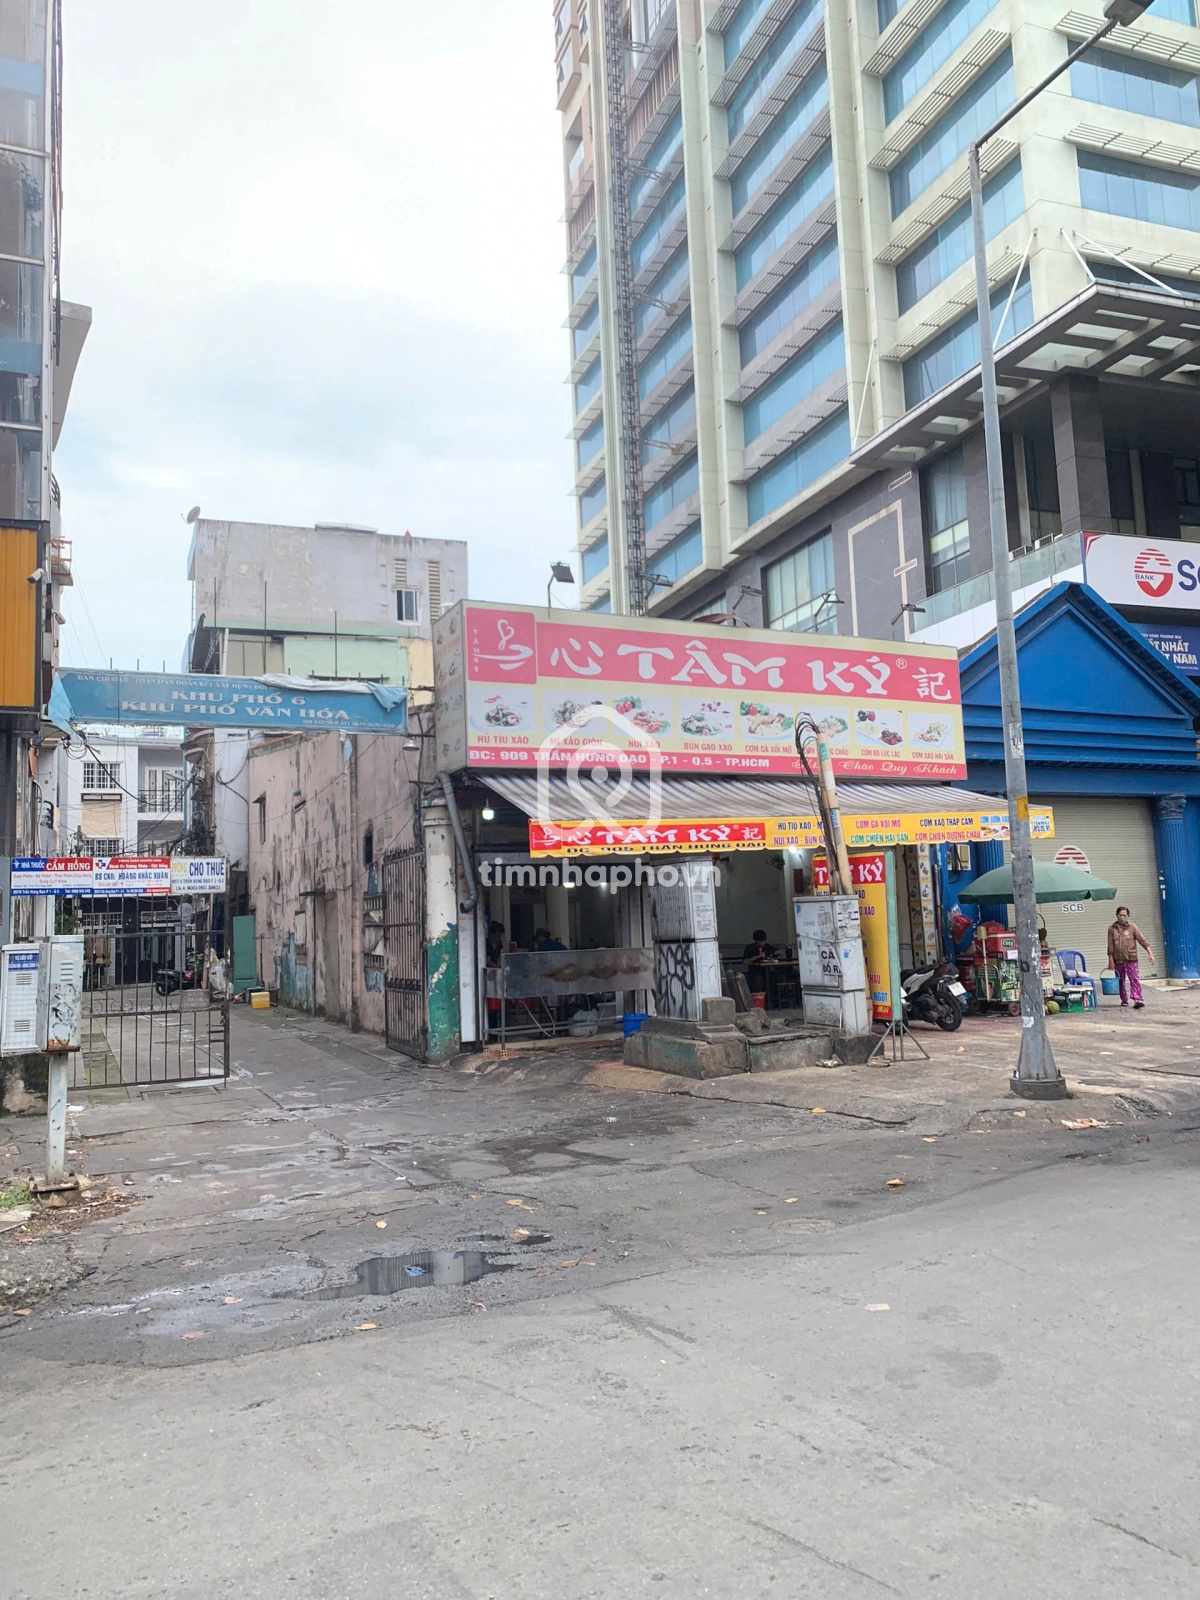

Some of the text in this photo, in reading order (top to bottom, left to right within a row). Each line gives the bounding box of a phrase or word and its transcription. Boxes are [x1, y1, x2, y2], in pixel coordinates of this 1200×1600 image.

[1162, 639, 1189, 652] NHẤT
[1173, 654, 1198, 664] NAM
[551, 638, 604, 676] 心
[617, 640, 786, 688] TÂM
[912, 667, 952, 700] 記
[172, 690, 306, 706] KHU PHỐ 6
[122, 700, 350, 720] KHU PHỐ VĂN HÓA
[478, 733, 490, 744] HỦ
[511, 734, 529, 744] XÀO
[563, 736, 580, 746] XÀO
[628, 740, 642, 748] NUI
[745, 744, 758, 752] CƠM
[760, 744, 769, 753] GÀ
[469, 750, 496, 760] ĐC:
[500, 751, 528, 761] 909
[532, 750, 572, 761] TRẦN
[576, 752, 614, 763] HƯNG
[618, 754, 646, 766] ĐẠO
[692, 757, 712, 766] Q.5
[725, 758, 770, 768] TP.HCM
[912, 751, 923, 759] CƠM
[838, 760, 874, 770] Chào
[914, 764, 957, 774] Khách
[856, 820, 869, 829] CƠM
[920, 818, 933, 827] CƠM
[568, 826, 592, 845] 心
[596, 826, 678, 844] TÂM
[741, 827, 762, 840] 記
[774, 836, 784, 845] NUI
[850, 834, 864, 844] CƠM
[915, 832, 928, 840] CƠM
[189, 862, 204, 876] CHO
[206, 858, 224, 876] THUÊ
[1062, 904, 1084, 912] SCB
